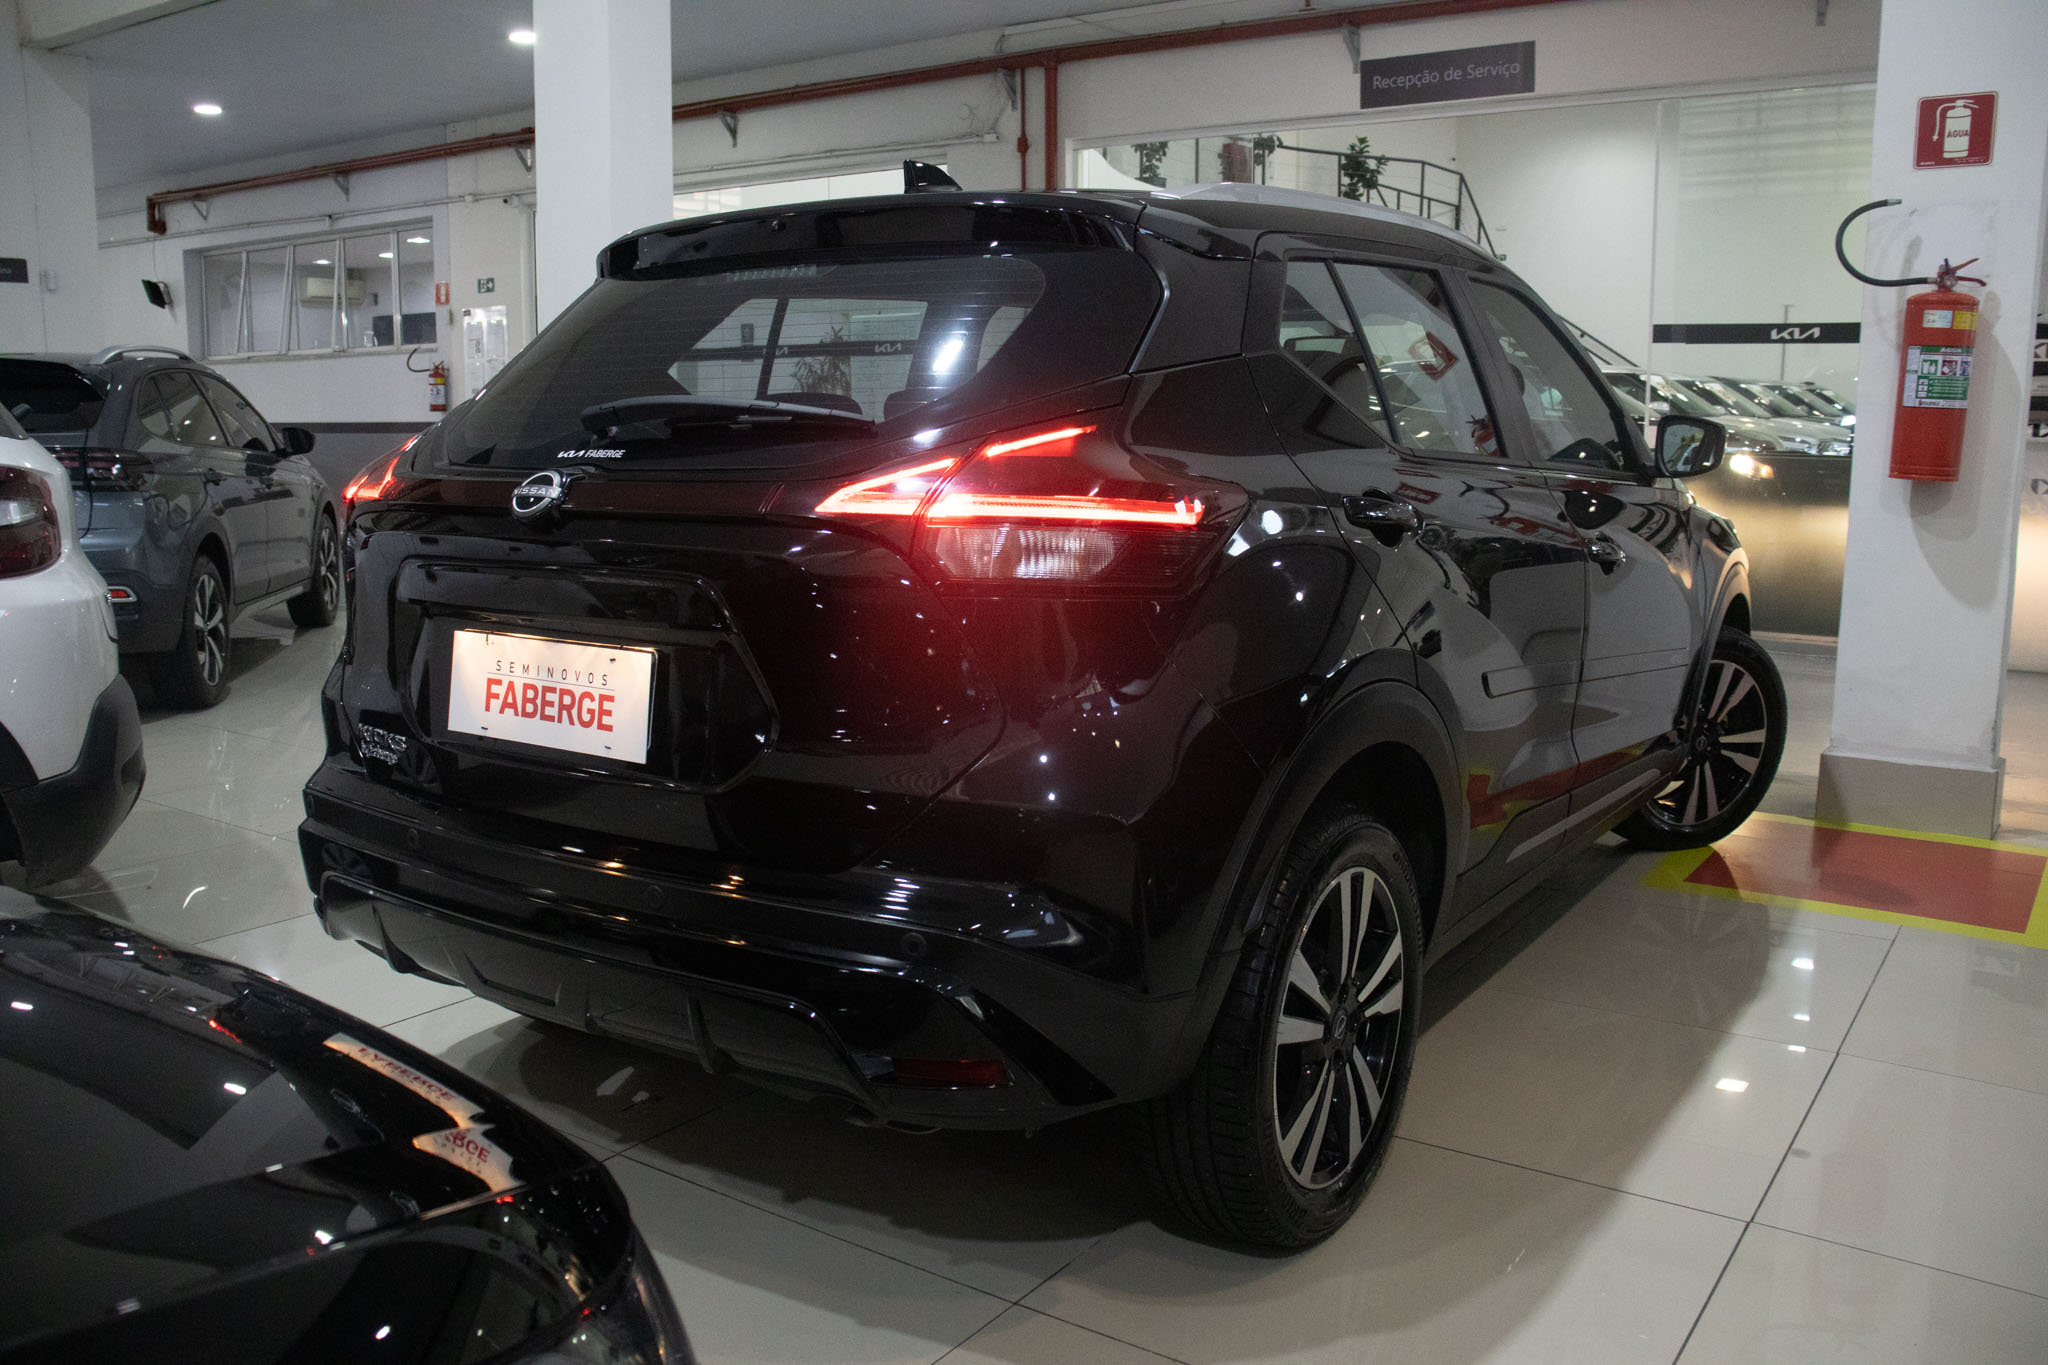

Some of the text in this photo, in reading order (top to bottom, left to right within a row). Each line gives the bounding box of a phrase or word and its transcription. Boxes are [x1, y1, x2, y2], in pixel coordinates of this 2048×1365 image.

[1373, 61, 1520, 90] Recepção de Serviço
[1770, 326, 1821, 340] KIA
[557, 449, 626, 458] KIA FABERGE
[513, 486, 560, 499] NISSAN
[495, 660, 608, 686] SEMINOVOS
[484, 677, 616, 732] FABERGE
